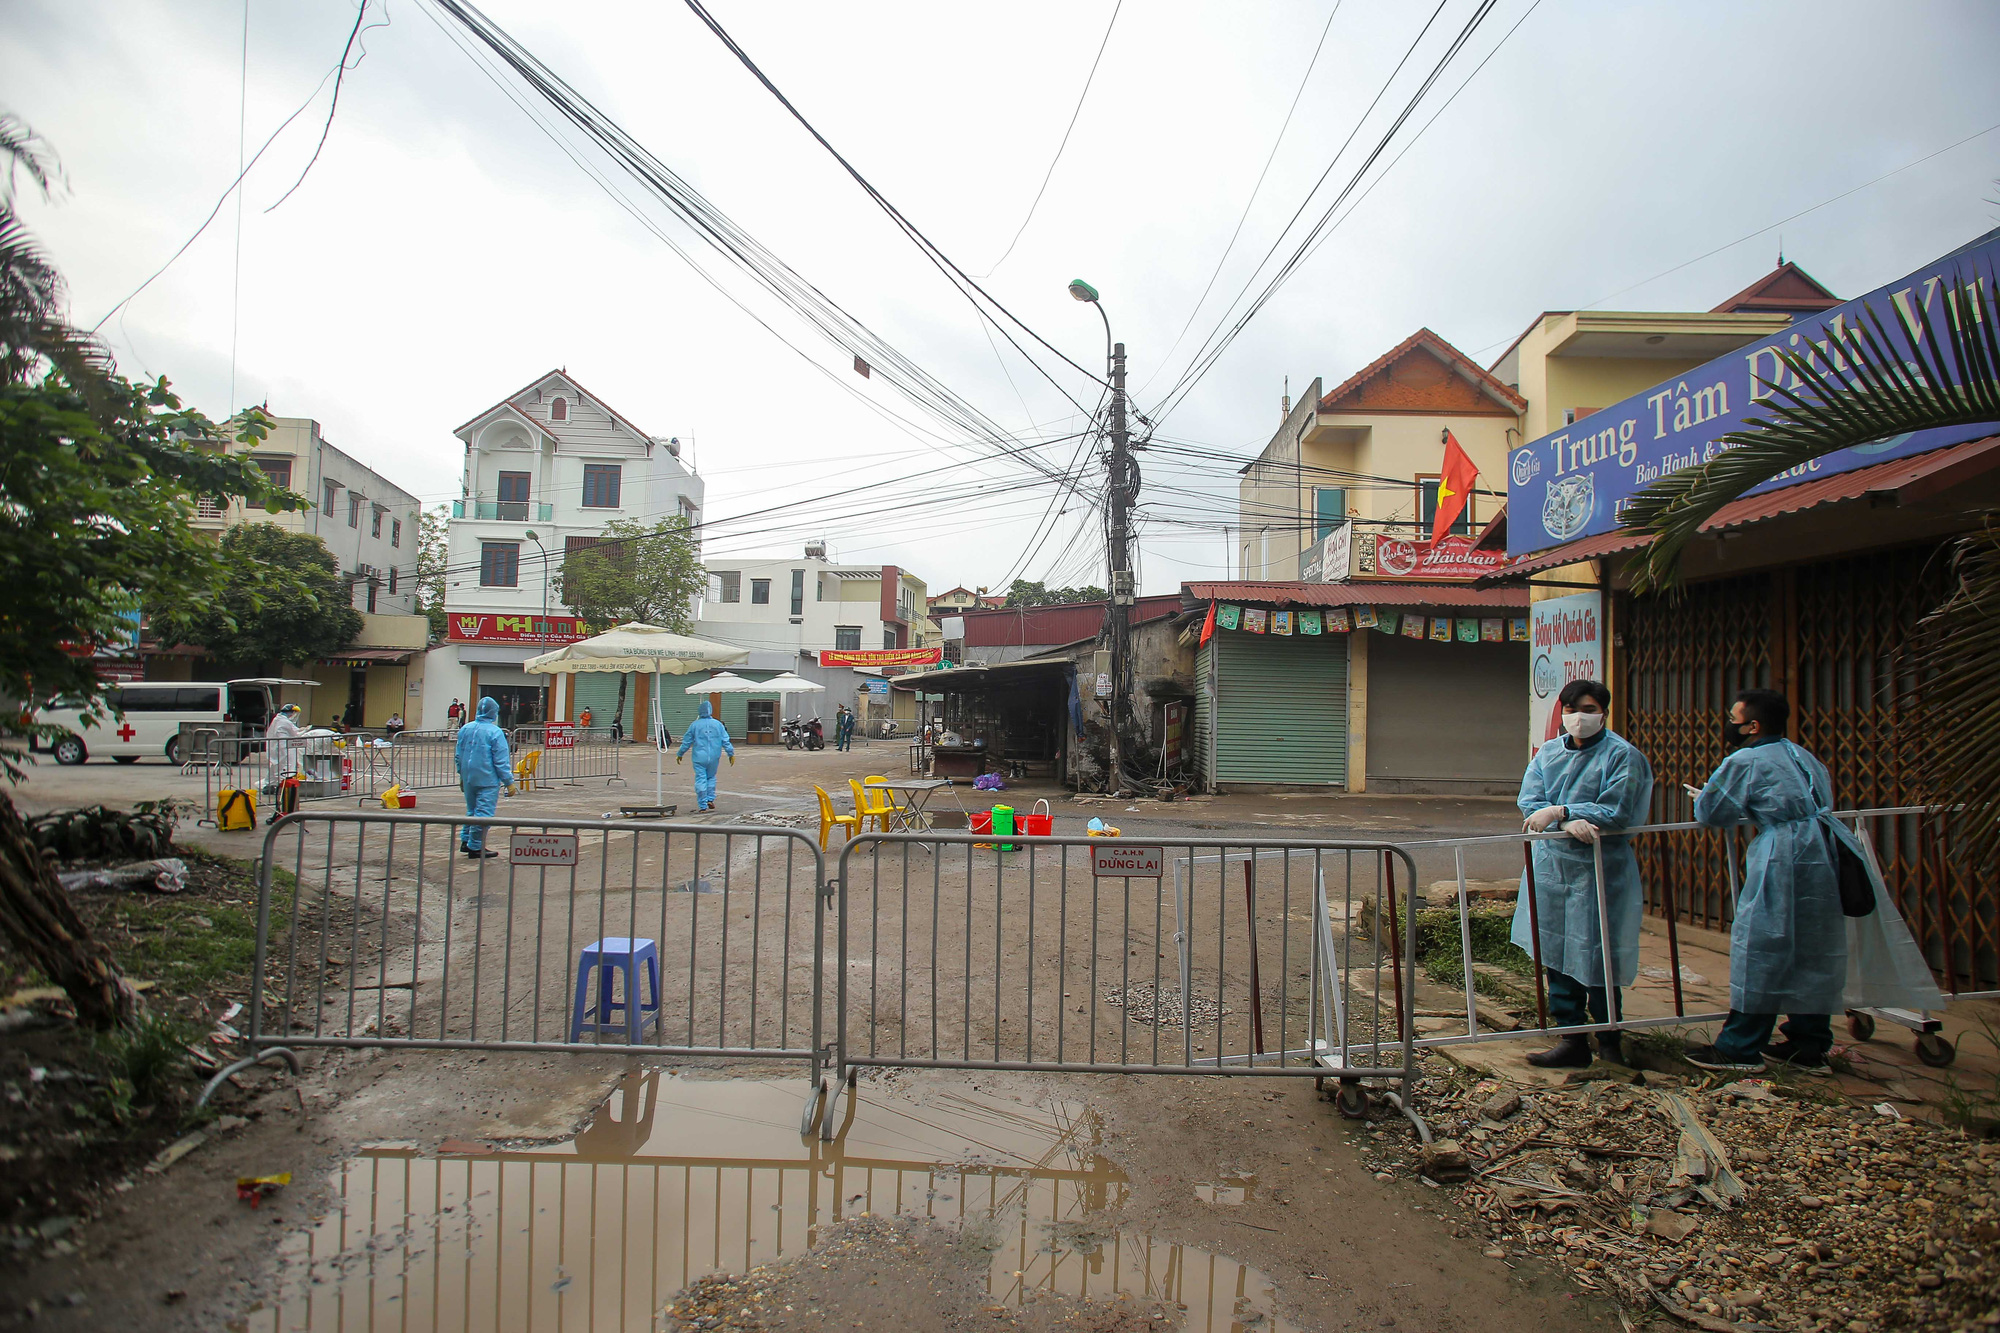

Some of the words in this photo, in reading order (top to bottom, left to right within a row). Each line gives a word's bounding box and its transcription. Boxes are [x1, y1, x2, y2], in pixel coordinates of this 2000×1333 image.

[1550, 418, 1638, 477] Trung
[1647, 381, 1730, 440] Tâm
[1745, 313, 1864, 405] Dịch
[1635, 461, 1658, 485] Bảo
[1661, 446, 1699, 475] Hành
[1703, 441, 1715, 463] &
[461, 616, 477, 628] MH
[496, 616, 533, 632] MH
[1562, 609, 1583, 648] Quách
[1584, 607, 1596, 642] Gia
[1564, 652, 1577, 686] TRẢ
[1578, 653, 1594, 682] GÓP
[548, 735, 564, 745] CÁCH
[565, 736, 572, 745] LY
[515, 845, 549, 857] DỪNG
[552, 849, 572, 859] LẠI
[1099, 857, 1134, 869] DỪNG
[1137, 860, 1158, 871] LẠI
